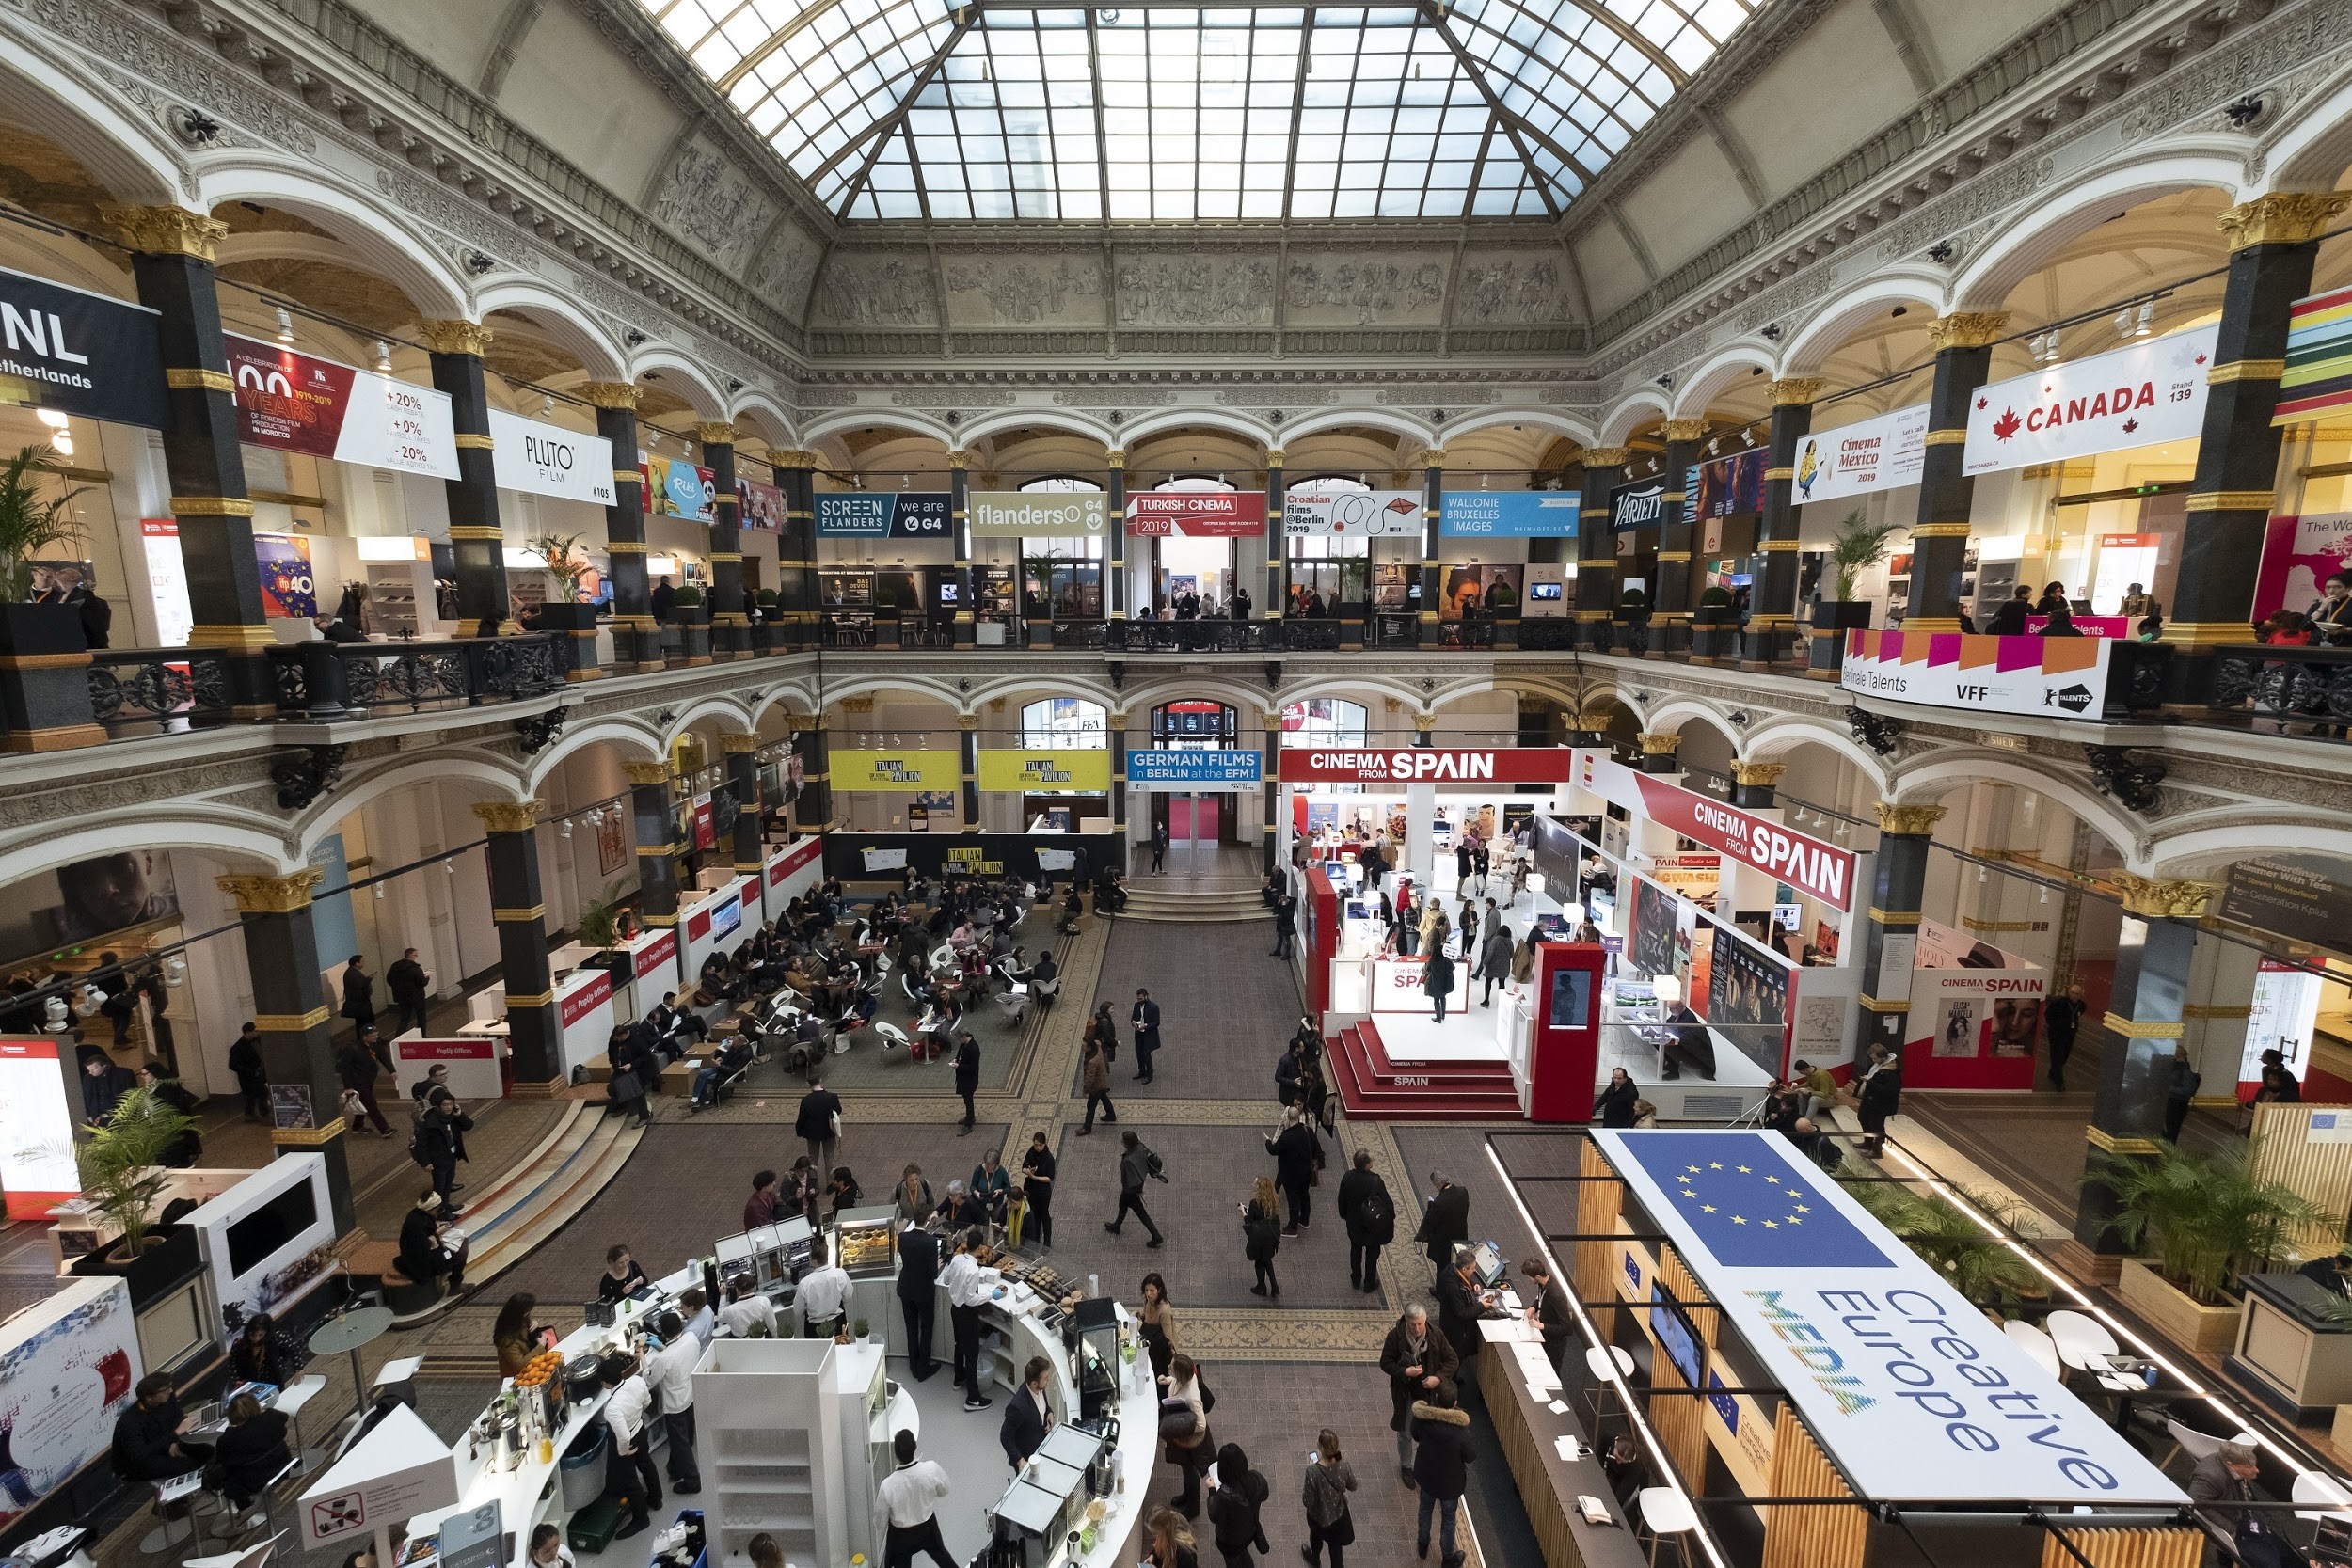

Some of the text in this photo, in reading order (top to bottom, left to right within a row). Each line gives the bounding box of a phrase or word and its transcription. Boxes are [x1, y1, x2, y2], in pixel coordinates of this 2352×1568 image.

[0, 301, 88, 365] NL
[243, 356, 283, 371] CELEBRATION
[0, 359, 92, 388] therlands
[2171, 380, 2194, 391] Stand
[295, 390, 332, 405] 1919-2019
[2169, 388, 2192, 403] 139
[242, 388, 317, 423] YEARS
[386, 403, 402, 412] CASH
[2026, 382, 2155, 432] CANADA
[260, 414, 287, 425] FOREIGN
[252, 420, 290, 433] PRODUCTION
[262, 429, 291, 438] MOROCCO
[1841, 437, 1882, 451] Cinema
[525, 435, 573, 470] PLUTO
[1838, 451, 1880, 467] México
[386, 457, 404, 466] VALUE
[406, 459, 426, 469] ADDED
[539, 468, 564, 483] FILM
[1857, 473, 1876, 483] 2019
[593, 485, 610, 499] #105
[673, 477, 696, 495] Riki
[1085, 500, 1103, 512] G4
[1142, 500, 1232, 511] TURKISH CINEMA
[1287, 495, 1330, 504] Croatian
[1449, 498, 1500, 508] WALLONIE
[821, 500, 882, 516] SCREEN
[900, 502, 945, 512] we are
[1287, 504, 1311, 514] films
[1614, 486, 1665, 527] VARIETY
[977, 504, 1065, 525] flanders
[1285, 515, 1325, 525] @Berlin
[1447, 510, 1500, 519] BRUXELLES
[822, 517, 882, 527] FLANDERS
[922, 518, 943, 530] G4
[1142, 521, 1168, 532] 2019
[1453, 521, 1492, 531] IMAGES
[2305, 521, 2329, 532] The
[1286, 525, 1310, 534] 2019
[291, 576, 313, 594] 40
[1842, 666, 1908, 693] Berlinale Talents
[1957, 684, 1989, 702] VFF
[2059, 693, 2090, 704] TALENTS
[876, 762, 902, 771] ITALIAN
[1025, 761, 1053, 771] ITALIAN
[1134, 754, 1255, 766] GERMAN FILMS
[1310, 752, 1494, 779] CINEMA SPAIN
[891, 771, 920, 782] PAVILION
[1041, 772, 1071, 782] PAVILION
[1135, 769, 1144, 779] in
[1146, 769, 1189, 779] BERLIN
[1191, 769, 1203, 779] at
[1205, 769, 1223, 779] the
[1359, 769, 1387, 779] FROM
[1694, 802, 1844, 900] CINEMA SPAIN
[1725, 837, 1748, 856] FROM
[948, 849, 980, 861] ITALIAN
[967, 862, 1003, 873] PAVILION
[2254, 858, 2328, 882] Extraordinary
[2235, 861, 2333, 892] Summer With Tess
[2247, 877, 2273, 888] Steven
[1557, 879, 1571, 899] WAR
[2250, 890, 2300, 911] Generation
[2301, 903, 2329, 918] Kplus
[649, 941, 675, 963] PopUp Offices
[1919, 945, 1946, 967] HOLY
[1394, 975, 1425, 988] SPA
[1941, 978, 2043, 993] CINEMA SPAIN
[578, 984, 610, 1009] PopUp Offices
[1953, 1001, 1967, 1010] ELISA
[1948, 1009, 1973, 1018] MARCELA
[1394, 1076, 1429, 1086] SPAIN
[1741, 1289, 1881, 1417] MEDIA
[1817, 1291, 2000, 1452] Europe
[1885, 1290, 2119, 1491] Creative
[1741, 1414, 1771, 1462] Creative
[1740, 1424, 1765, 1466] Europe
